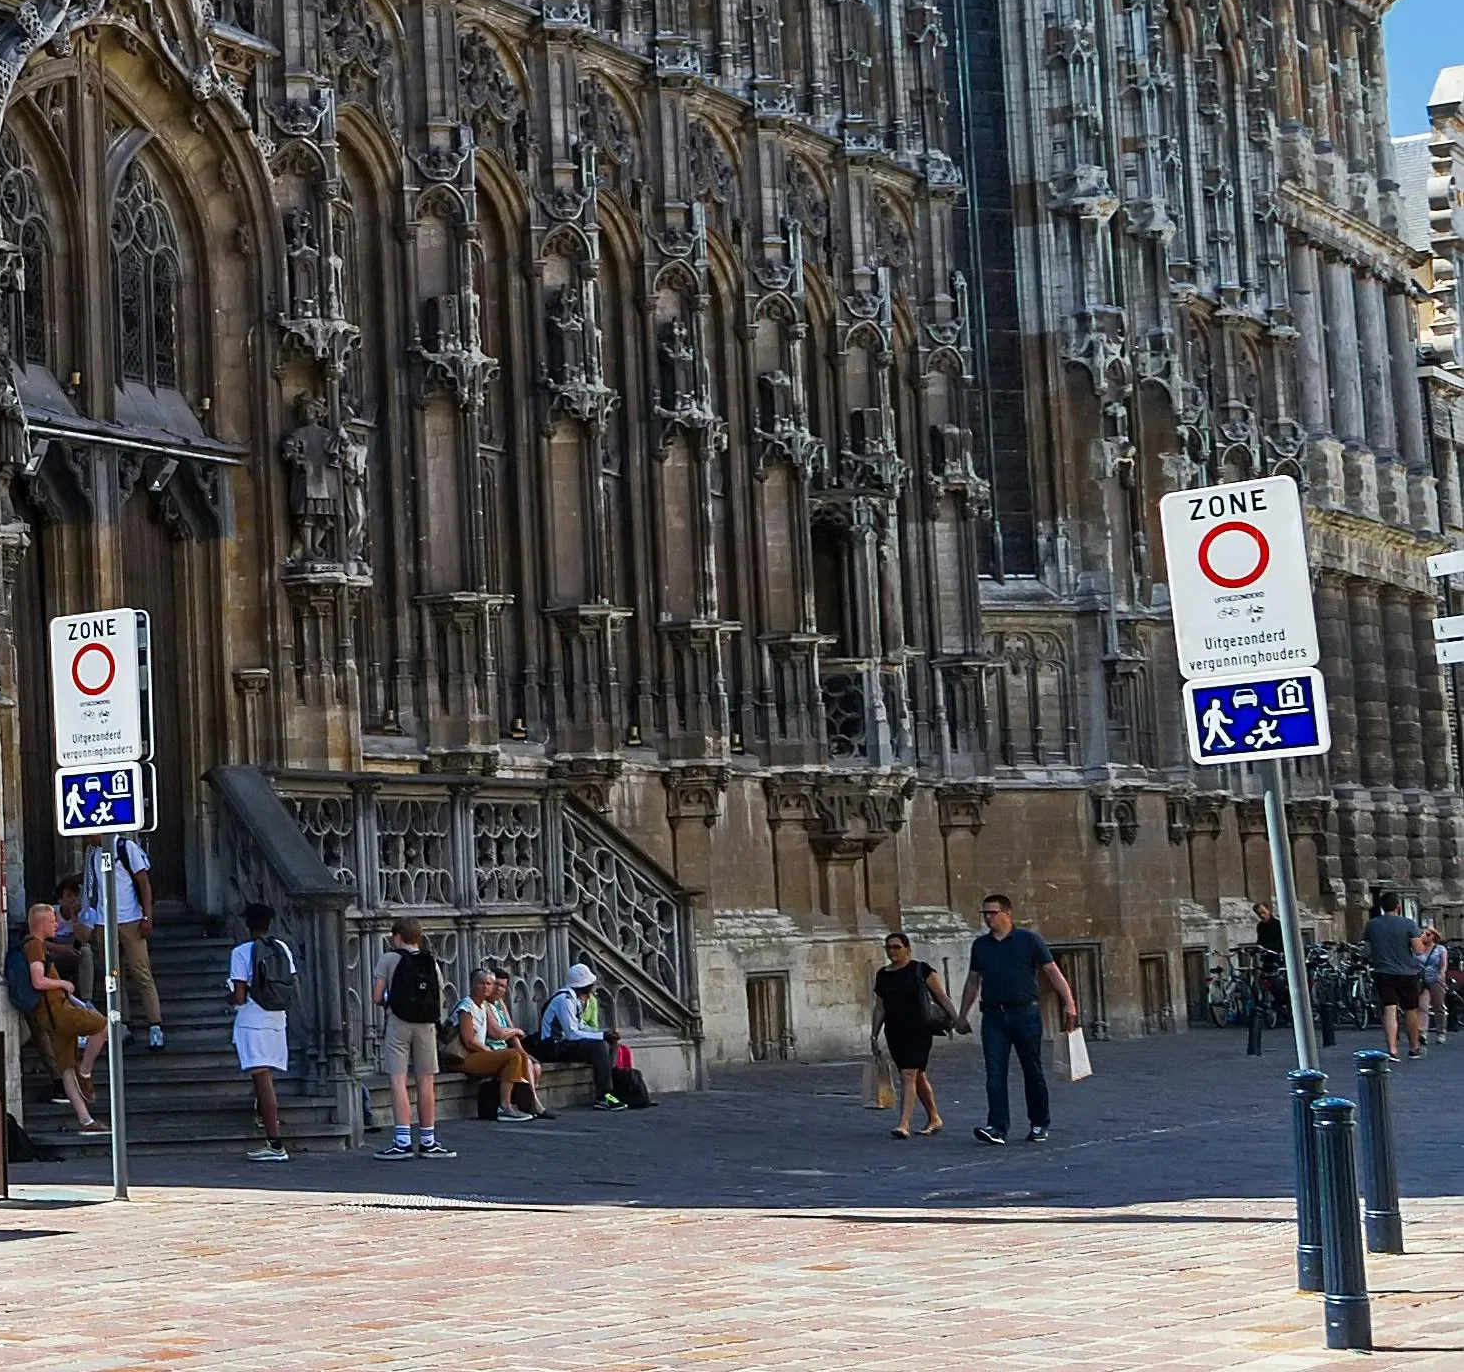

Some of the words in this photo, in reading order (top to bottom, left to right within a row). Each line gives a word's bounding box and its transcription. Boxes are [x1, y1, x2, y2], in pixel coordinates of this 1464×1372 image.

[1188, 489, 1267, 520] ZONE
[68, 618, 116, 640] ZONE
[1204, 629, 1286, 651] Uitgezonderd
[1189, 648, 1307, 672] vergunninghouders
[72, 729, 122, 745] Uitgezonderd
